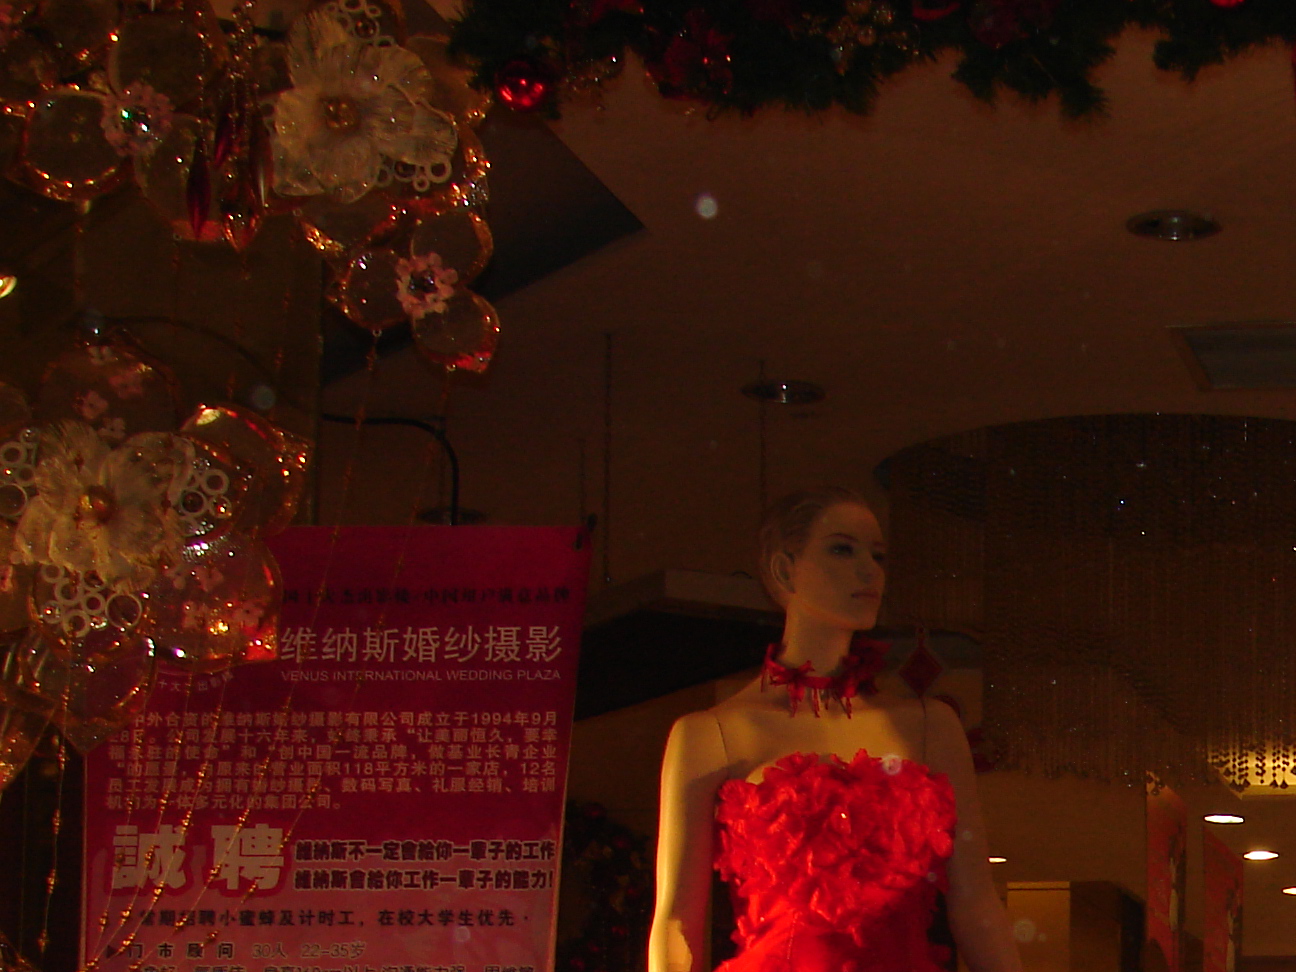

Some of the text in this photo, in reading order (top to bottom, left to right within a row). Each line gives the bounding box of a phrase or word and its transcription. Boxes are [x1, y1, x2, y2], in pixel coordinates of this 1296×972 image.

[280, 625, 563, 664] 维纳斯婚纱摄影
[281, 669, 561, 681] VENUS INTERNATIONAL WEDDING PLAZA
[112, 823, 285, 890] 誠聘
[127, 941, 367, 960] 门市顾问 30人 22-35岁
